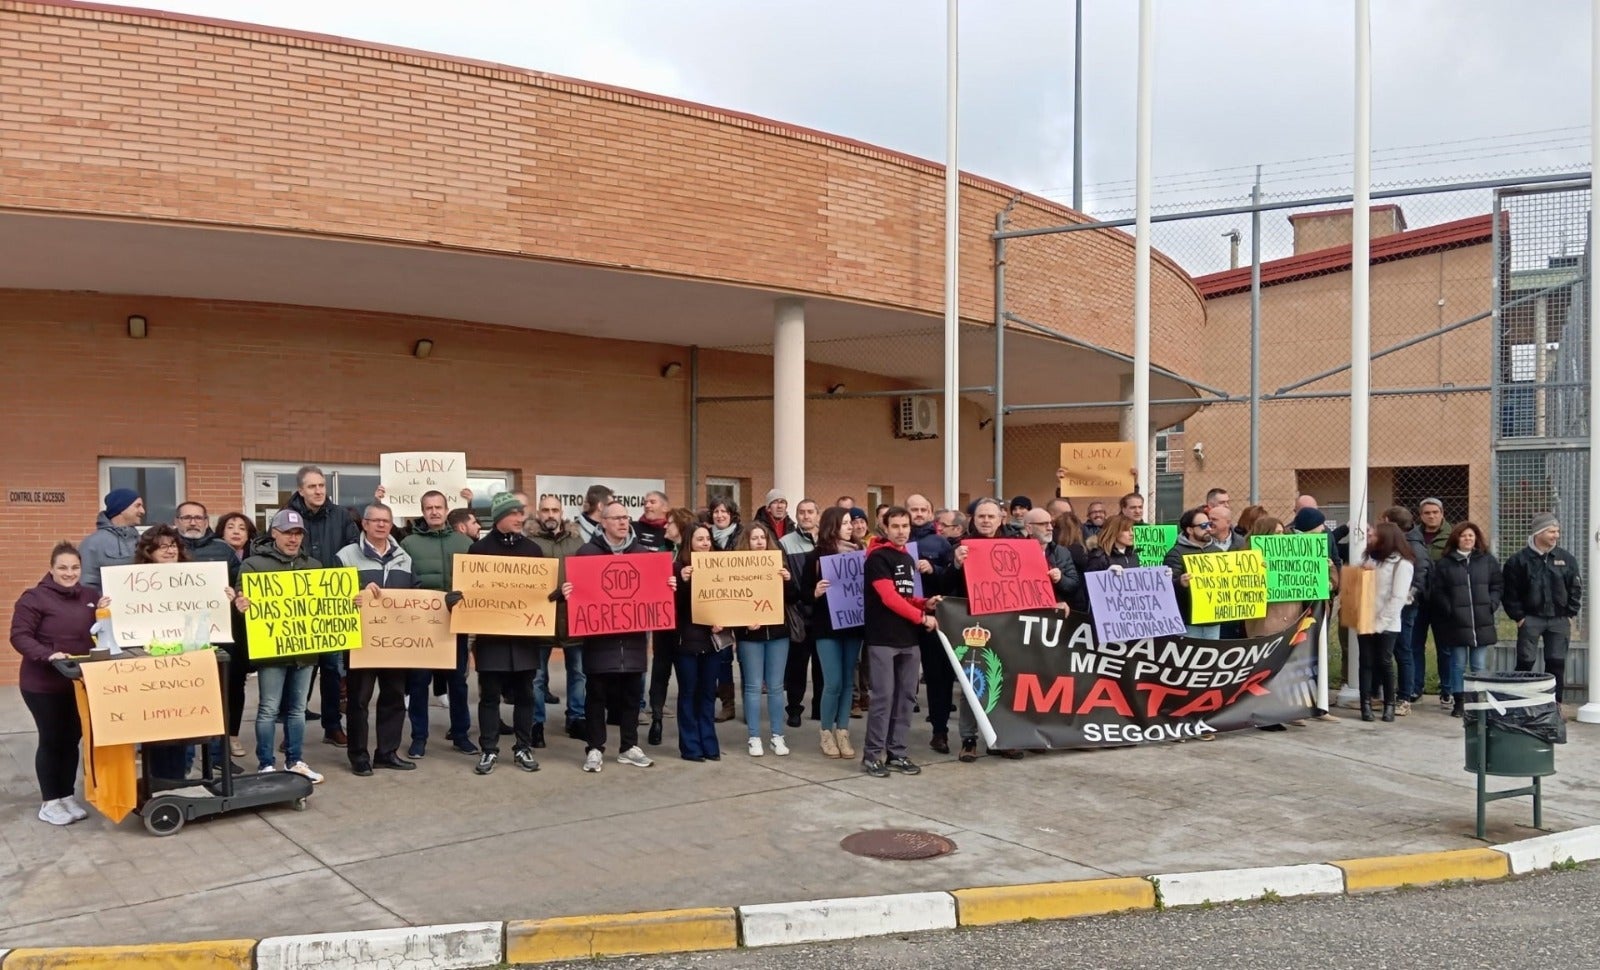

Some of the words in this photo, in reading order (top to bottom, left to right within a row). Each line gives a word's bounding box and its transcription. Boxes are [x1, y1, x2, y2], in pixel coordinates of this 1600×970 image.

[10, 491, 32, 502] CONTROL
[34, 491, 41, 502] DE
[42, 491, 65, 502] ACCESOS
[1316, 538, 1327, 558] DE
[461, 561, 549, 576] FUNCIONARIOS
[993, 550, 1017, 572] STOP
[1187, 555, 1214, 573] MAS
[1216, 554, 1232, 573] DE
[1235, 553, 1259, 573] 400
[1302, 560, 1320, 574] CON
[123, 571, 162, 592] 156
[247, 574, 283, 597] MAS
[293, 572, 314, 596] DE
[319, 571, 352, 597] 400
[472, 580, 484, 588] de
[604, 569, 638, 590] STOP
[1216, 575, 1229, 588] SIN
[698, 587, 753, 599] AUTORIDAD
[973, 578, 1054, 613] AGRESIONES
[1206, 591, 1213, 604] Y
[1217, 590, 1230, 603] SIN
[1234, 589, 1264, 603] COMEDOR
[125, 602, 153, 615] SIN
[157, 600, 220, 613] SERVICIO
[284, 597, 306, 617] SIN
[368, 597, 442, 610] COLAPSO
[458, 598, 528, 610] AUTORIDAD
[753, 599, 773, 612] YA
[1105, 594, 1161, 611] MACHISTA
[574, 600, 672, 634] AGRESIONES
[1119, 611, 1156, 621] CONTRA
[1214, 603, 1256, 619] HABILITADO
[265, 622, 274, 637] Y
[282, 617, 307, 636] SIN
[311, 617, 358, 634] COMEDOR
[523, 613, 546, 627] YA
[1103, 616, 1184, 640] FUNCIONARIAS
[121, 631, 136, 640] DE
[370, 635, 434, 648] SEGOVIA
[1018, 615, 1063, 647] TU
[1068, 622, 1283, 672] ABANDONO
[275, 634, 347, 655] HABILITADO
[107, 661, 147, 675] 156
[1070, 652, 1126, 678] ME
[1134, 660, 1253, 688] PUEDE
[103, 684, 128, 695] SIN
[139, 677, 205, 692] SERVICIO
[1013, 668, 1271, 717] MATAR
[110, 712, 126, 722] DE
[1083, 719, 1217, 742] SEGOVIA
